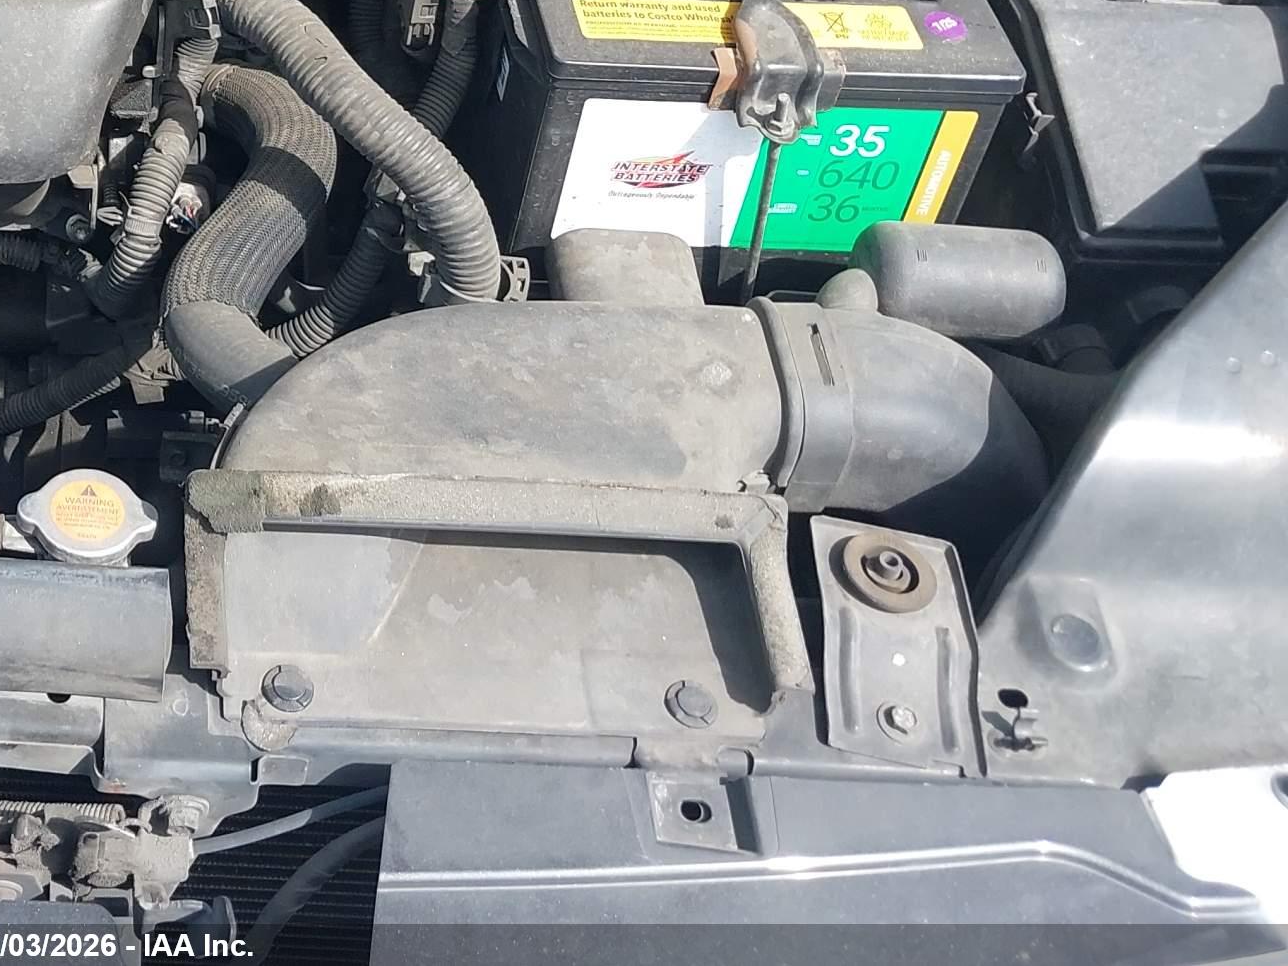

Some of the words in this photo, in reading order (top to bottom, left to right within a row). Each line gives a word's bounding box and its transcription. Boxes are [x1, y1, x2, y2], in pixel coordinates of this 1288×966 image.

[579, 0, 617, 8] Return
[620, 1, 669, 12] warranty
[672, 3, 692, 11] and
[695, 5, 721, 13] used
[583, 9, 632, 18] batteries
[648, 12, 682, 21] Costco
[829, 124, 891, 158] 35
[614, 161, 713, 176] INTERSTATE
[818, 160, 900, 190] 640
[614, 172, 699, 183] BATTERIES
[916, 150, 953, 216] AUTOMOTIVE
[808, 193, 861, 223] 36
[65, 497, 114, 507] WARNING
